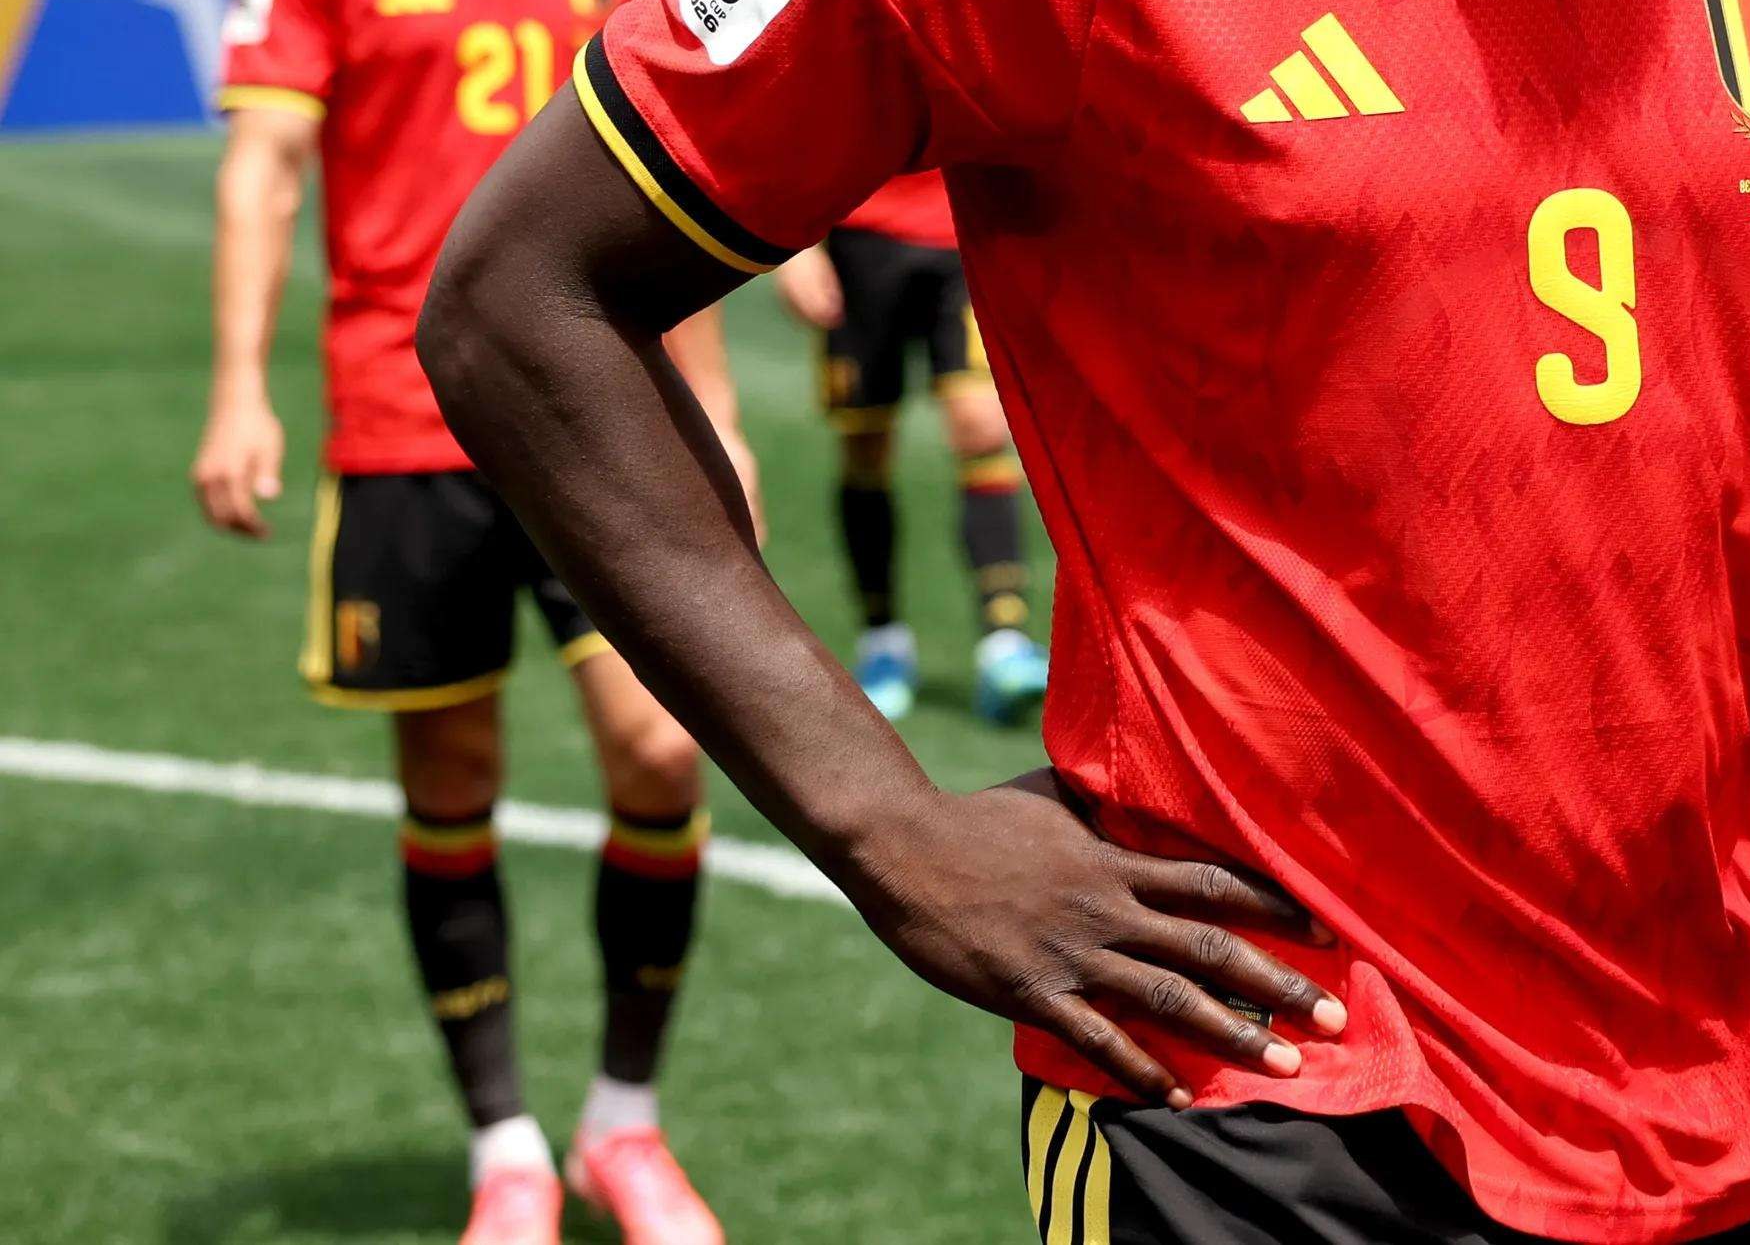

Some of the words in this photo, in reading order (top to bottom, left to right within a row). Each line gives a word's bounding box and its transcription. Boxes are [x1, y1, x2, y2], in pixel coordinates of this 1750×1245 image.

[709, 0, 727, 20] CUP
[456, 22, 555, 134] 21
[1528, 188, 1642, 425] 9
